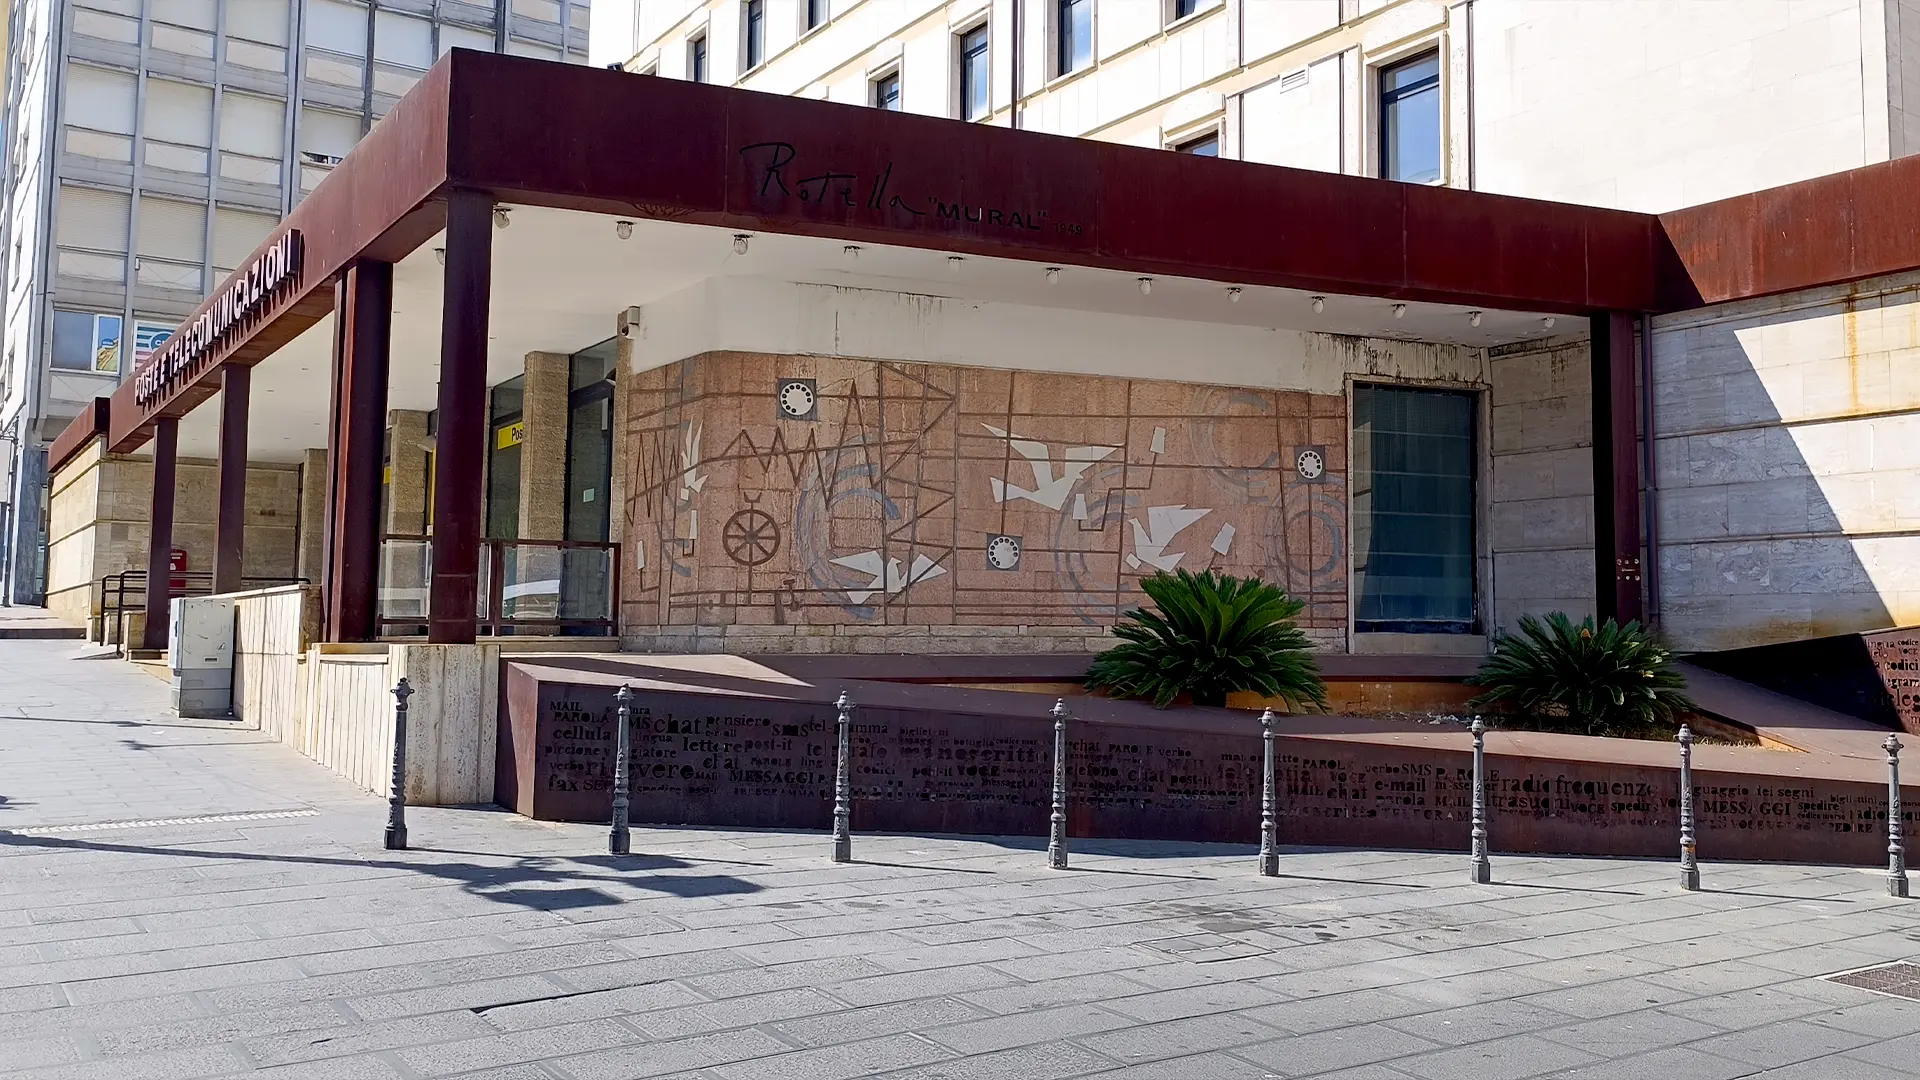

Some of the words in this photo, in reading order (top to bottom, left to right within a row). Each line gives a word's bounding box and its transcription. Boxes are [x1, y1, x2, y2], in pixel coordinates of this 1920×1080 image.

[928, 197, 1048, 231] "MURAL"
[1054, 223, 1084, 236] 1949
[135, 358, 159, 405] POSTE
[169, 229, 298, 378] TELECOMUNICAZIONI
[550, 702, 583, 712] MAIL
[553, 711, 609, 724] PAROLA
[653, 713, 701, 735] chat
[545, 742, 601, 756] piccione
[744, 737, 793, 752] post-it
[1073, 739, 1100, 751] chat
[1109, 743, 1154, 755] PAROE
[1158, 747, 1192, 757] verbo
[729, 769, 814, 784] MESSAGGI
[1065, 763, 1119, 777] elefono
[1365, 763, 1400, 774] verbo
[1402, 764, 1432, 776] SMS
[549, 773, 578, 792] fax
[1287, 783, 1324, 796] MAIL
[1375, 777, 1427, 792] e-mail
[1676, 783, 1749, 799] lguaggio
[1777, 786, 1815, 800] segni
[1830, 794, 1877, 805] biglittini
